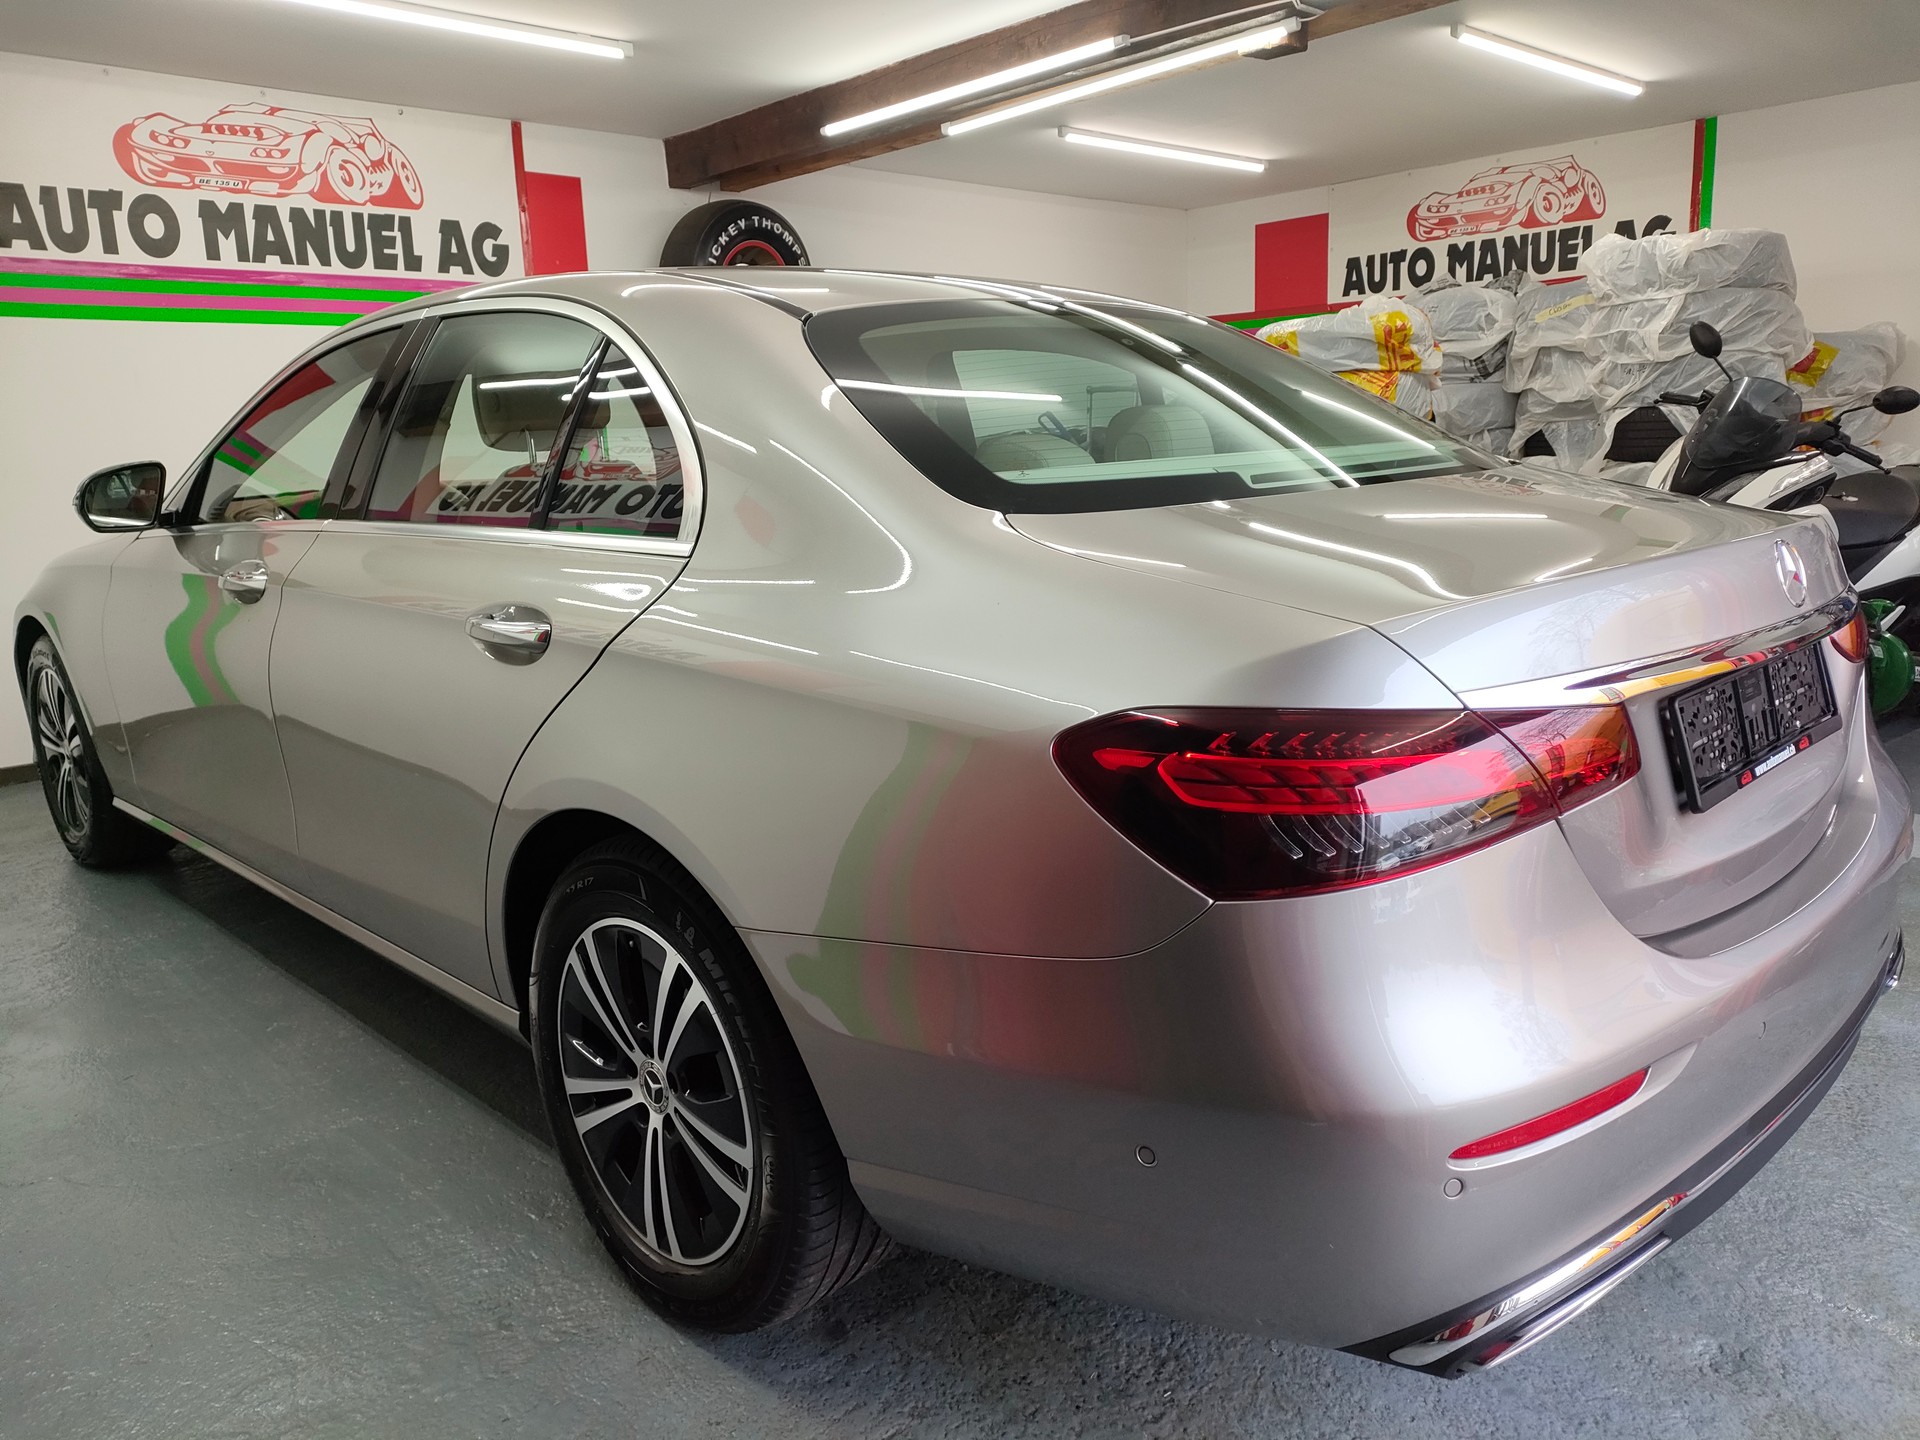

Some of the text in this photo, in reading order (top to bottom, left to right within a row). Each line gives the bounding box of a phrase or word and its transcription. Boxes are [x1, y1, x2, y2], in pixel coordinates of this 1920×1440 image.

[0, 182, 510, 278] AUTO MANUEL AG
[708, 215, 806, 266] ICKEY THOMPS
[1342, 247, 1436, 298] AUTO
[1447, 224, 1594, 283] MANUEL
